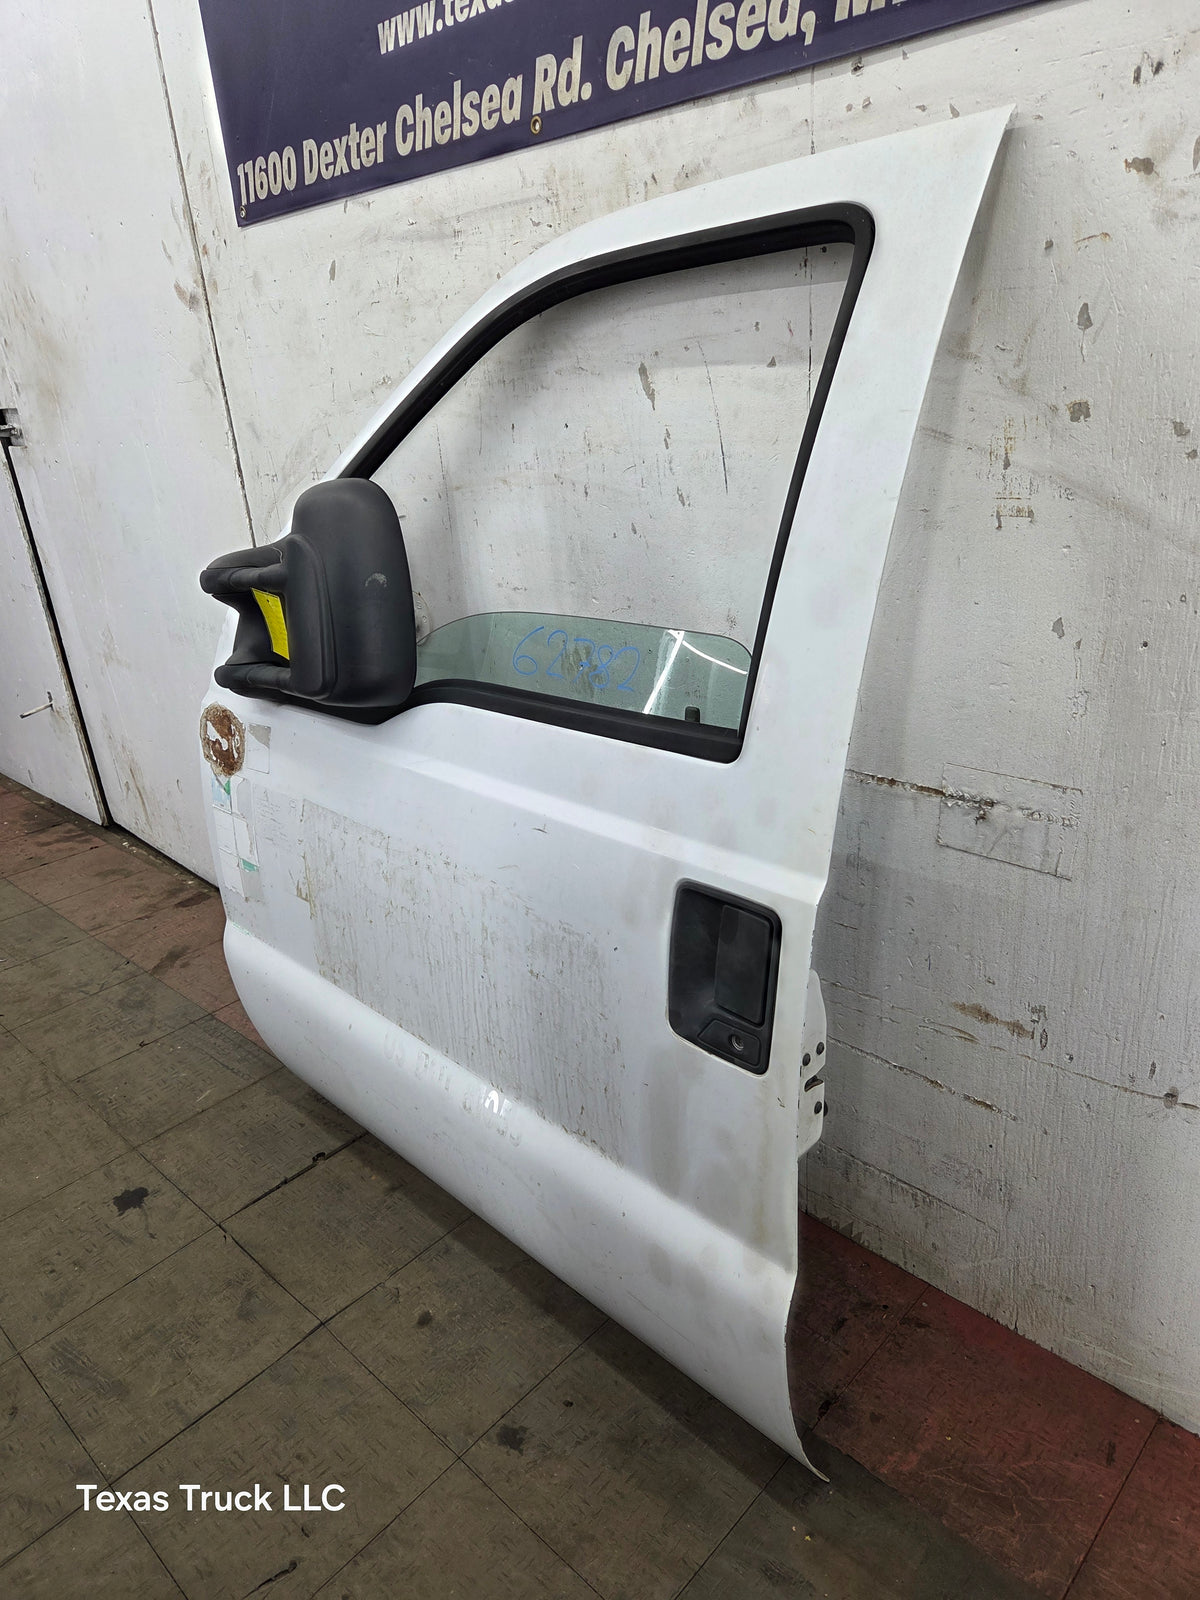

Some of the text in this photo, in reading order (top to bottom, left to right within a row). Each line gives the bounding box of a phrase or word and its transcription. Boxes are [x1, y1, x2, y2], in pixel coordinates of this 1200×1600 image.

[237, 0, 817, 206] 11600 Dexter Chelsea Rd. Chelsea,
[512, 626, 641, 692] 62782
